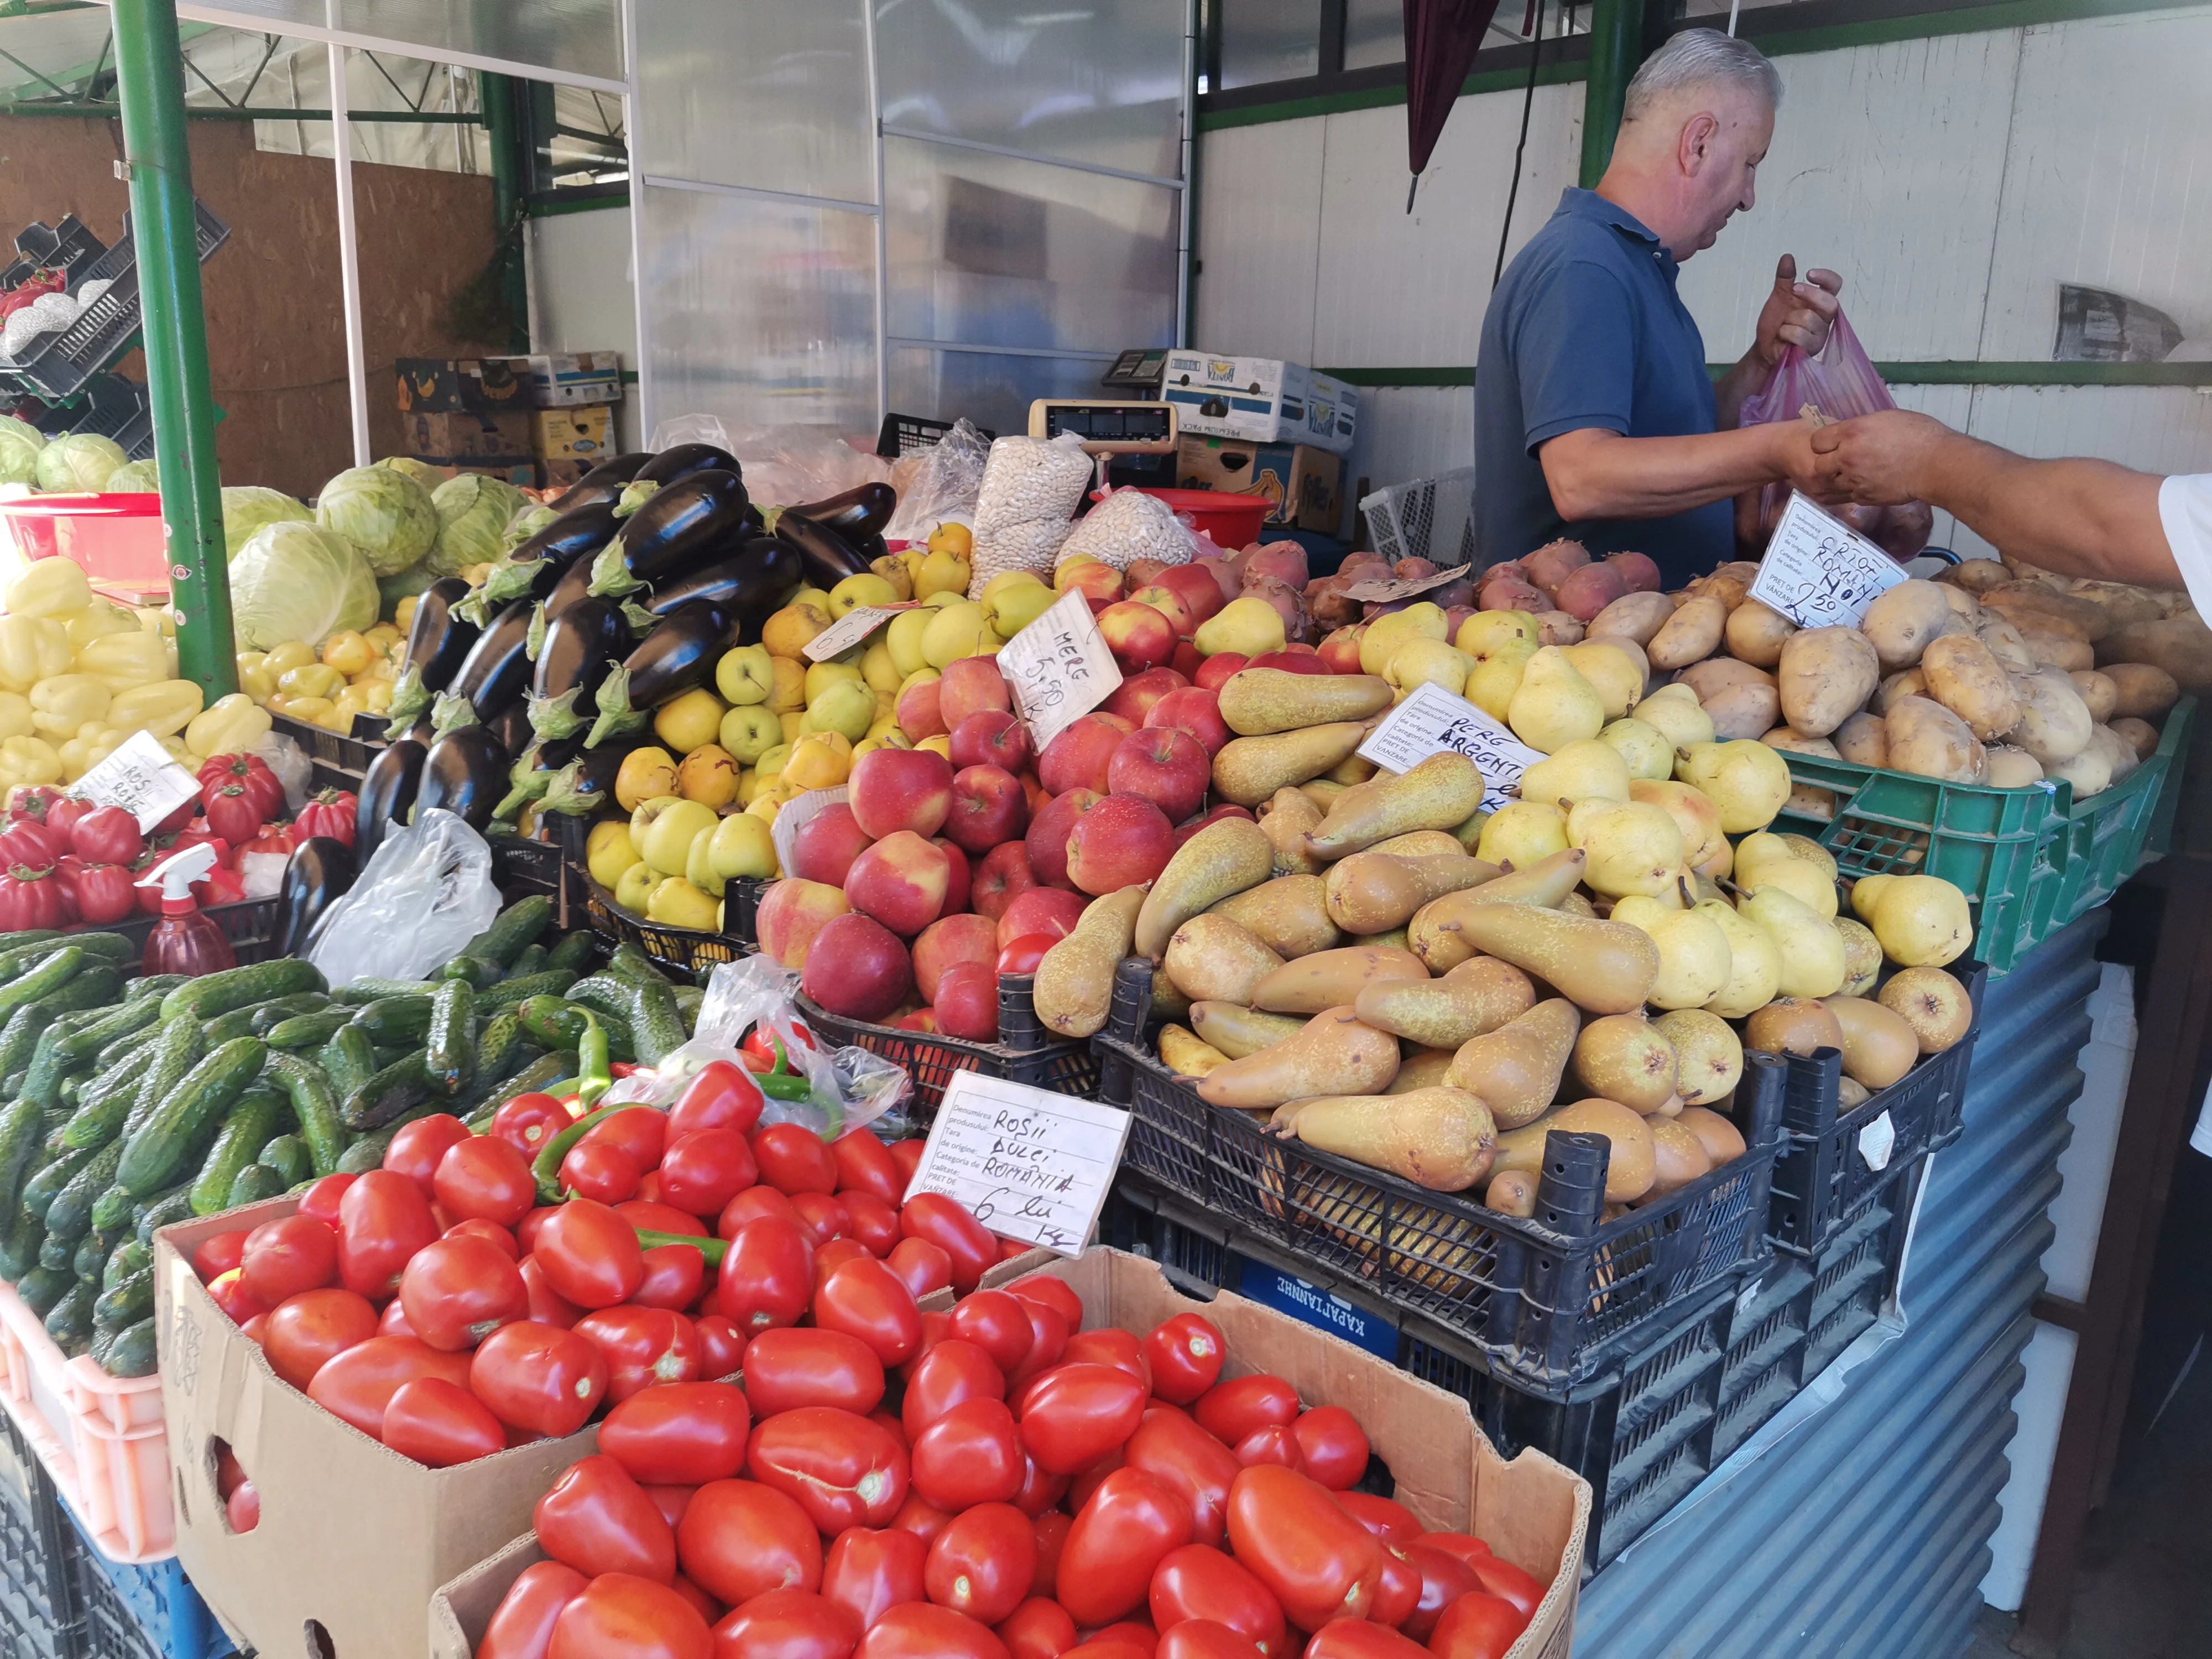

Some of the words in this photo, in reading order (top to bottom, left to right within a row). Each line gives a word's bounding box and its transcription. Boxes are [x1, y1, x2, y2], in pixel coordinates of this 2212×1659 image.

[1181, 422, 1202, 431] PACK
[1204, 425, 1240, 437] PREMIUM
[1785, 583, 1796, 594] DE
[1417, 700, 1453, 718] Denumirea
[1392, 725, 1423, 743] Categoria
[1424, 739, 1434, 748] de
[1383, 738, 1399, 749] PRET
[1399, 746, 1410, 755] DE
[953, 1104, 992, 1120] Denumirea
[945, 1127, 961, 1137] Tara
[948, 1117, 989, 1132] produsului:
[940, 1139, 950, 1147] de
[951, 1142, 978, 1155] origine:
[936, 1151, 969, 1166] Categoria
[932, 1164, 960, 1176] calitate:
[946, 1177, 957, 1186] DE
[974, 1187, 1010, 1222] 6
